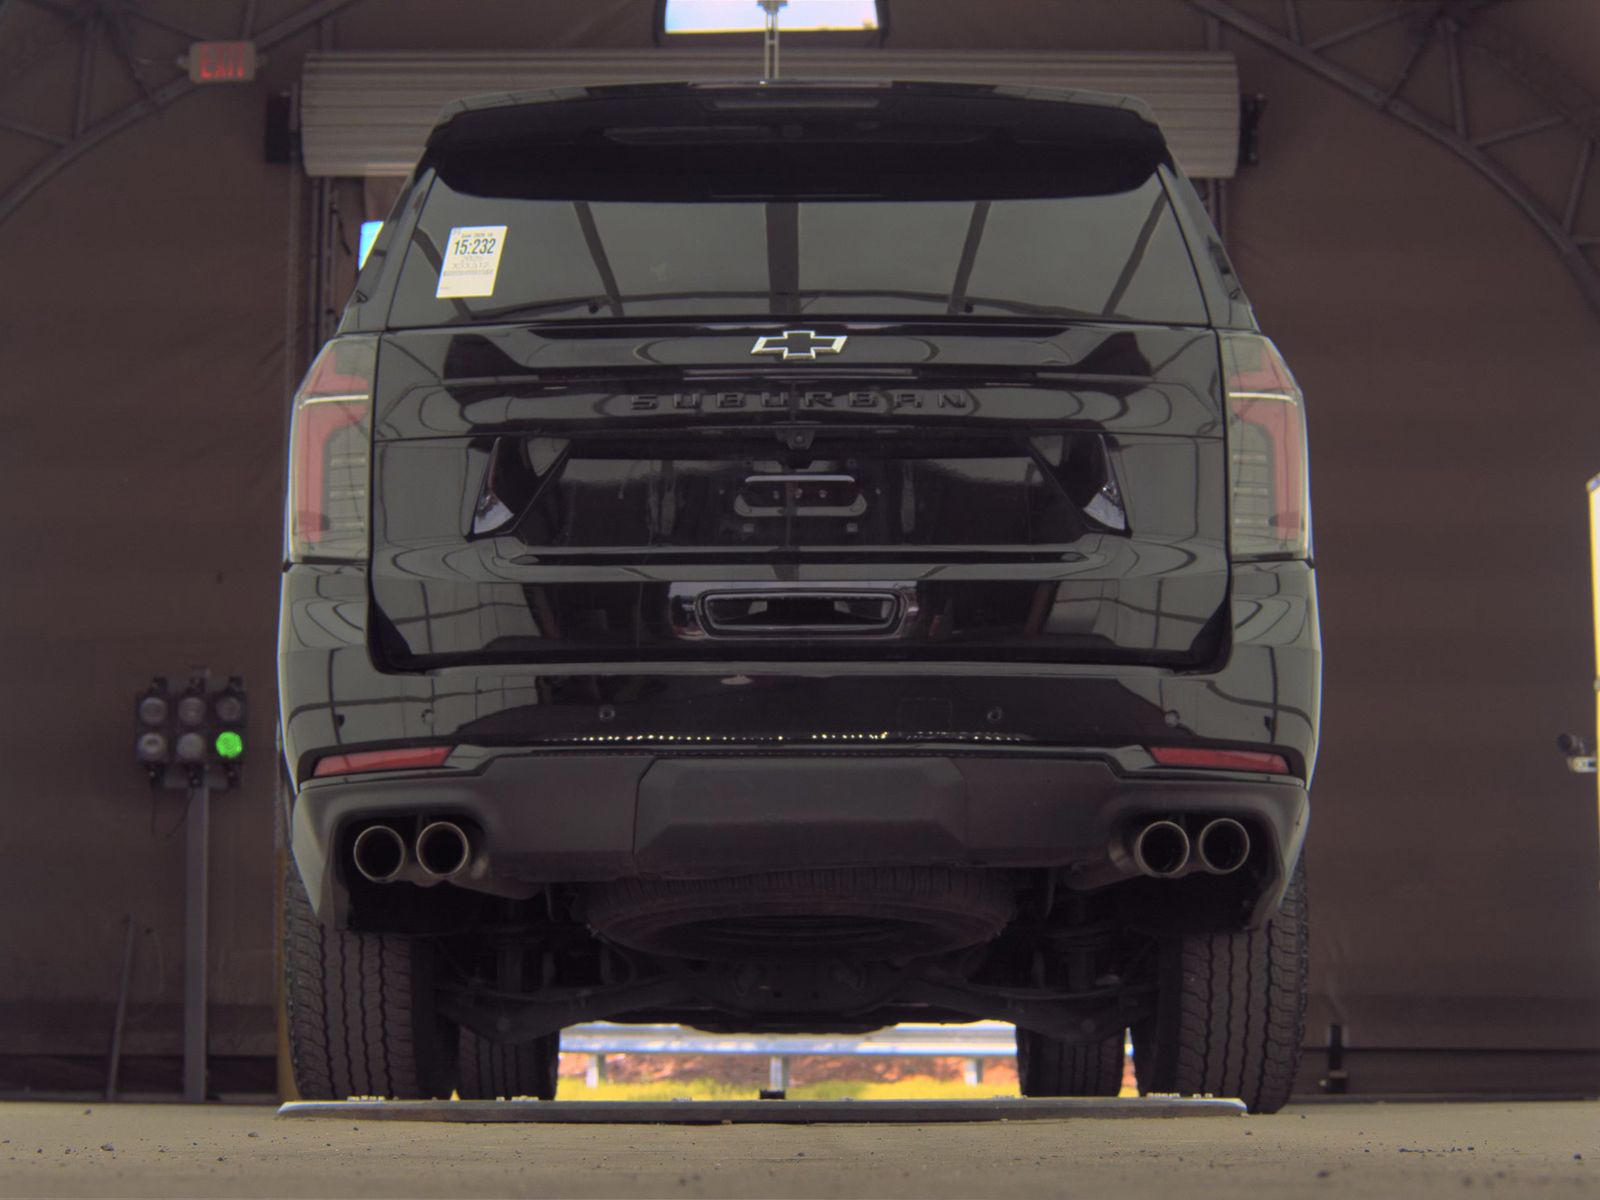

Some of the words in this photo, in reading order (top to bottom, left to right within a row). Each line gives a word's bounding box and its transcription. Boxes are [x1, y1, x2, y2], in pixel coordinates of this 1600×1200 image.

[200, 45, 246, 80] EXIT
[453, 238, 496, 256] 15:232
[630, 390, 968, 411] SUBURBAN
